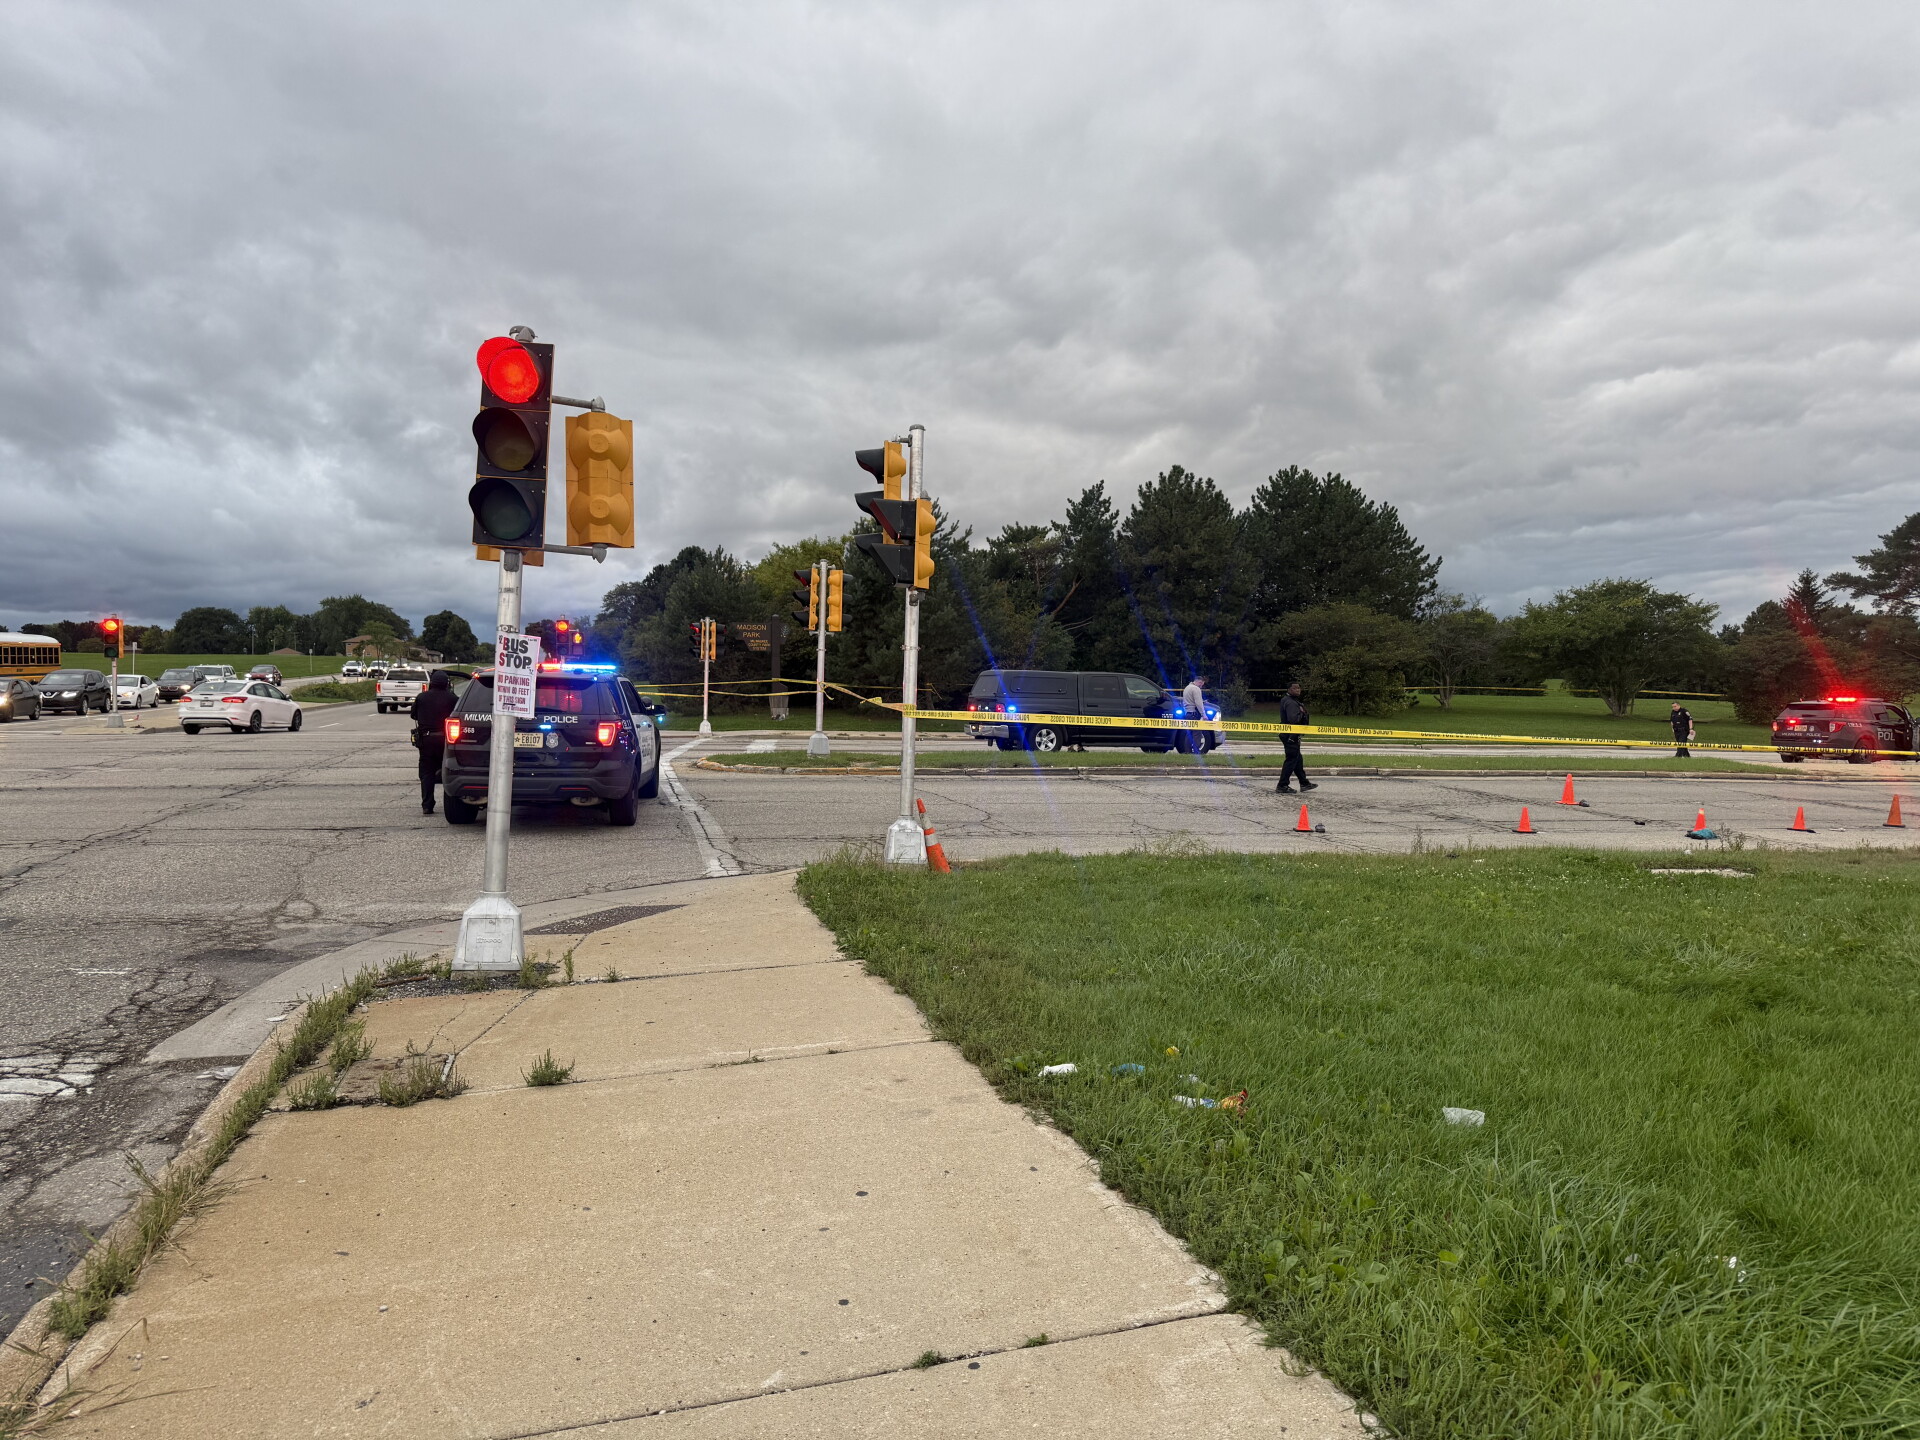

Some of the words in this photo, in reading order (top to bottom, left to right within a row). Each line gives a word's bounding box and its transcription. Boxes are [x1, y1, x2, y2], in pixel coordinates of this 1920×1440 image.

[503, 636, 528, 654] BUS
[499, 652, 532, 670] STOP
[504, 675, 530, 686] PARKING
[518, 688, 530, 696] FEET
[544, 716, 578, 724] POLICE
